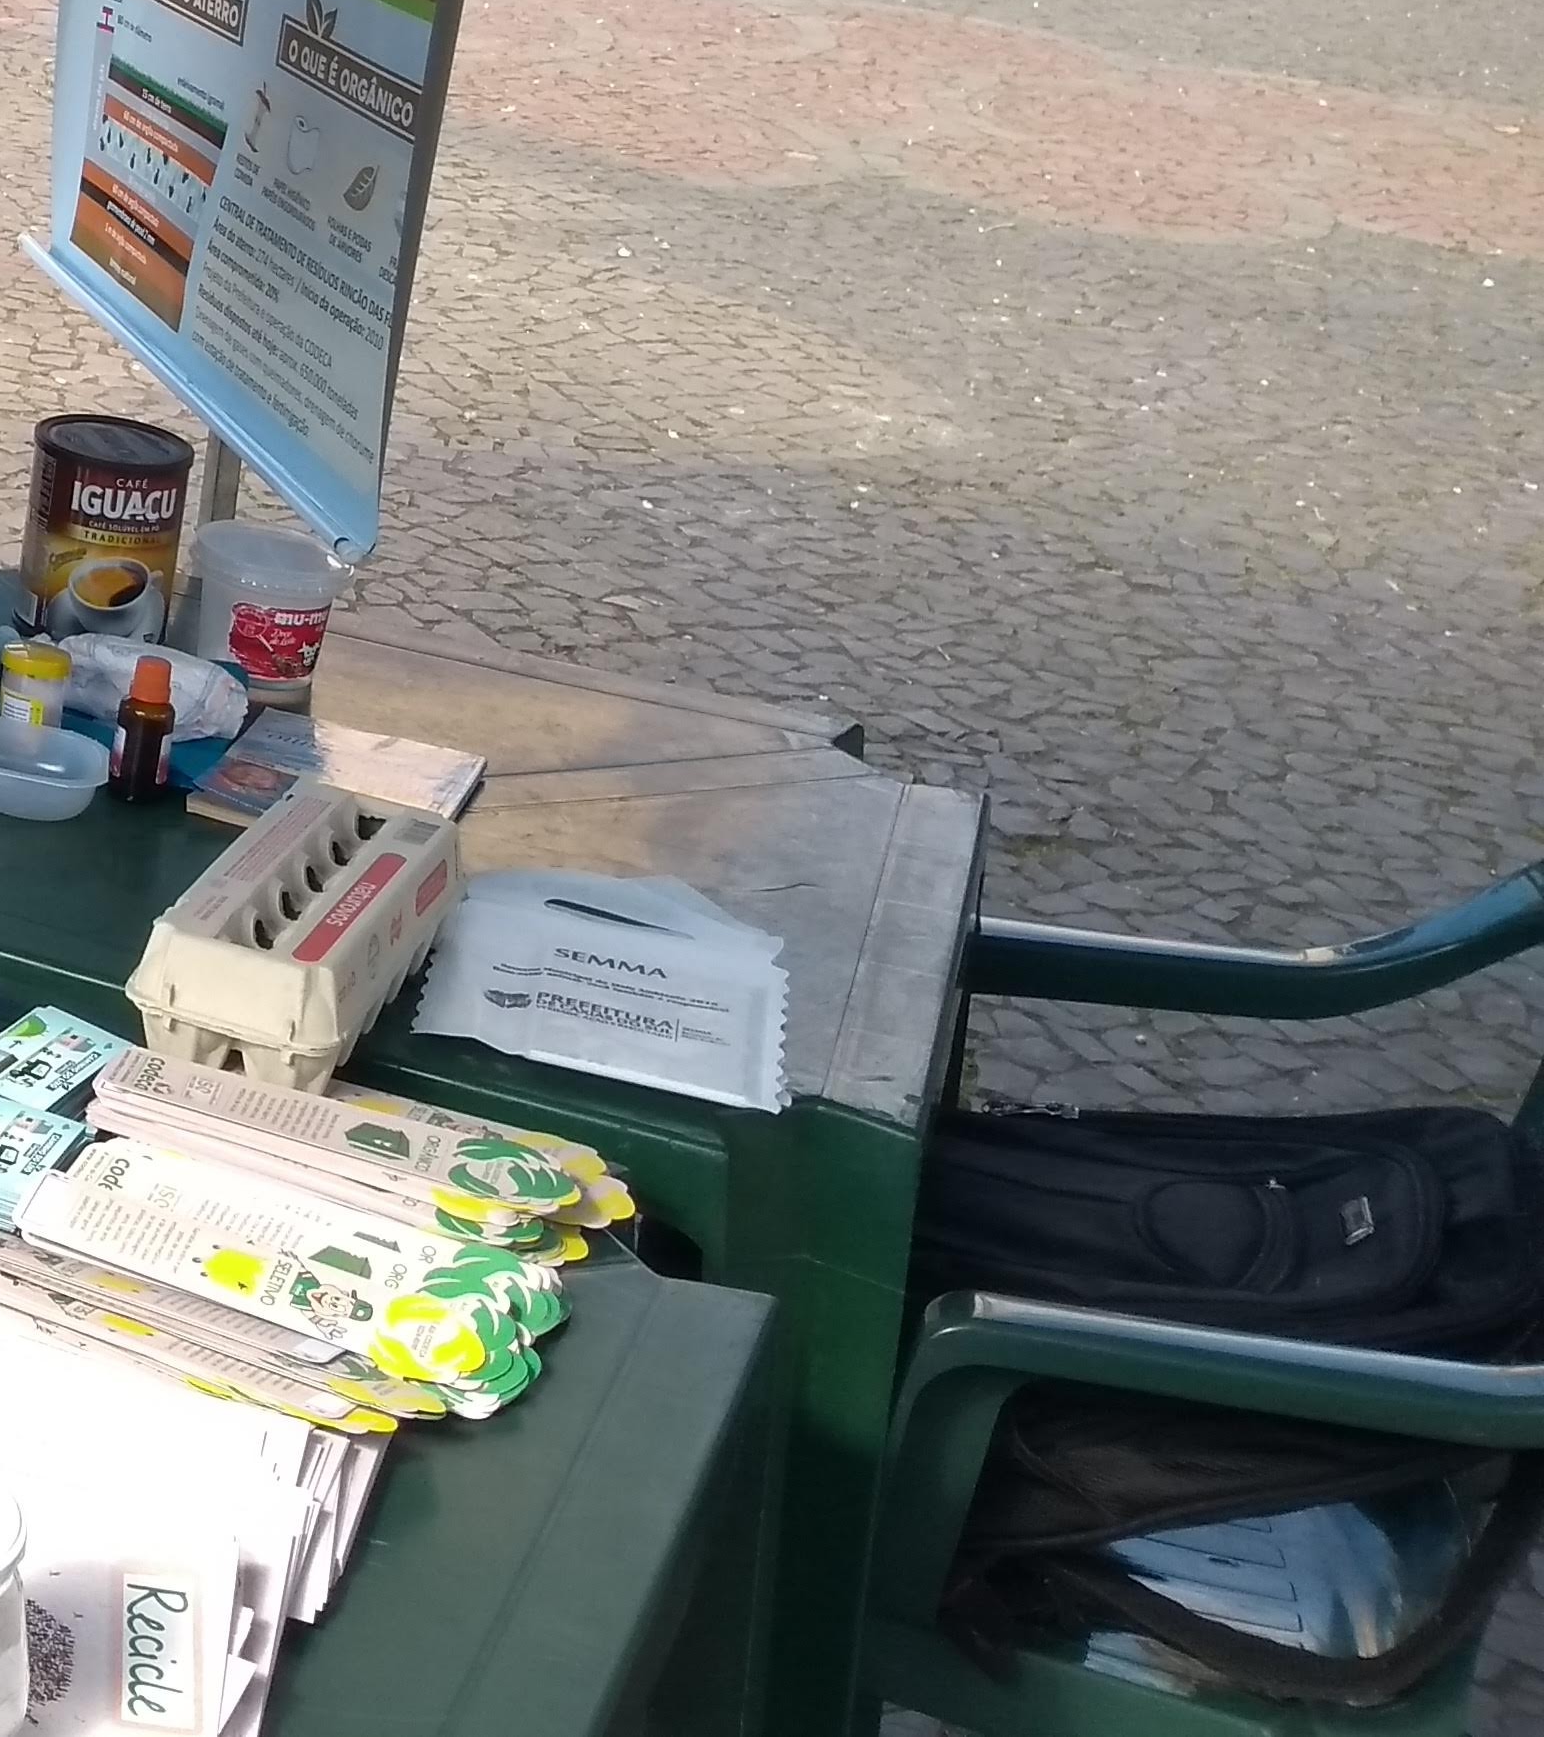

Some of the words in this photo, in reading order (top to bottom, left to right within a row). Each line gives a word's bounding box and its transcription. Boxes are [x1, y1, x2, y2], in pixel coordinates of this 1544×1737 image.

[289, 39, 297, 63] O
[301, 46, 325, 80] QUE
[328, 56, 338, 86] É
[340, 69, 413, 127] ORGÂNICO
[70, 480, 178, 523] IGUAÇU
[116, 477, 149, 490] CAFÉ
[89, 519, 107, 531] CAFÉ
[326, 881, 377, 928] naturovos
[554, 947, 668, 980] SEMMA
[537, 990, 675, 1031] PREFEITURA
[134, 1056, 165, 1092] codeca
[414, 1134, 442, 1173] ORGÂNICO
[260, 1259, 293, 1306] SELETIVO
[126, 1581, 189, 1717] Recicle
